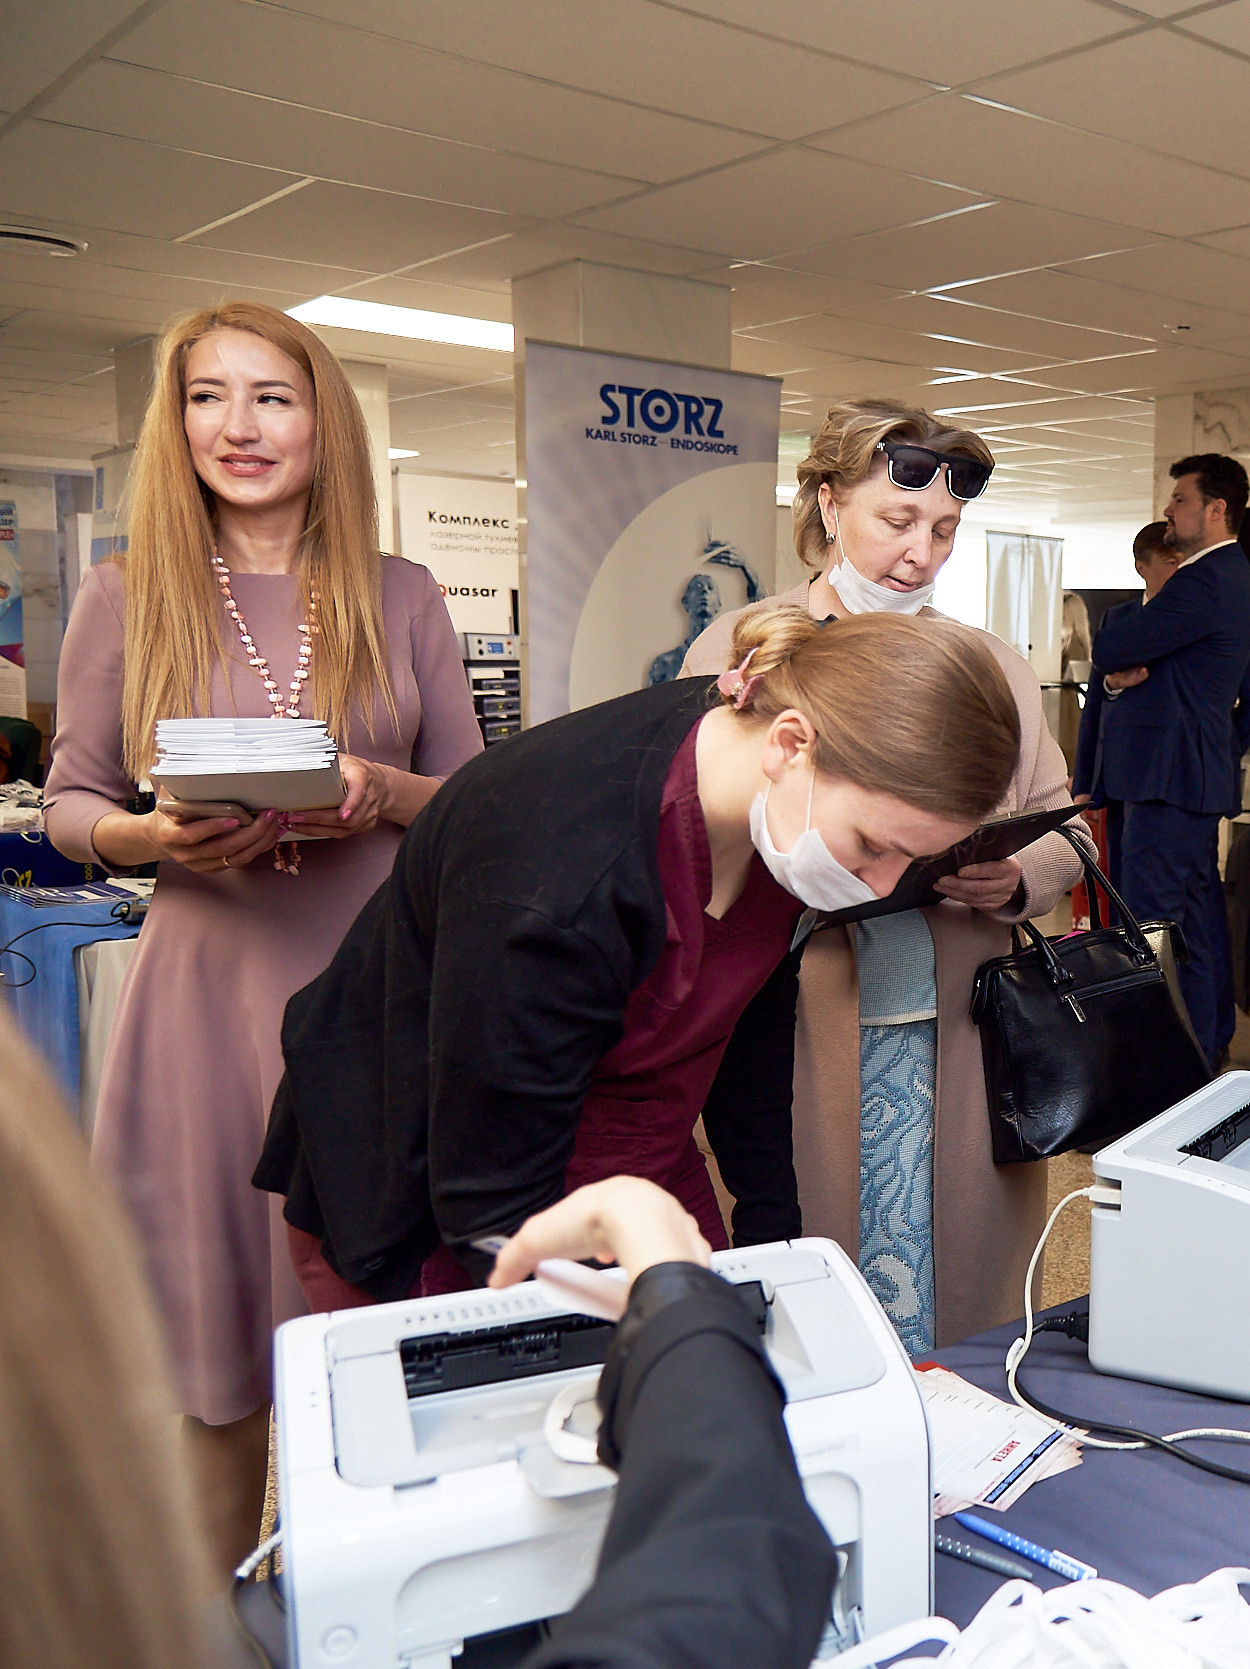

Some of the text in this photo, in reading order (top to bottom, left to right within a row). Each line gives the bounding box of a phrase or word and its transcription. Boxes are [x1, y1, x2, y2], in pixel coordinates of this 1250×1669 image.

[600, 384, 725, 439] STORZ
[585, 428, 739, 456] KARL STORZ ENDOSKOPE
[428, 510, 510, 529] Комплекс
